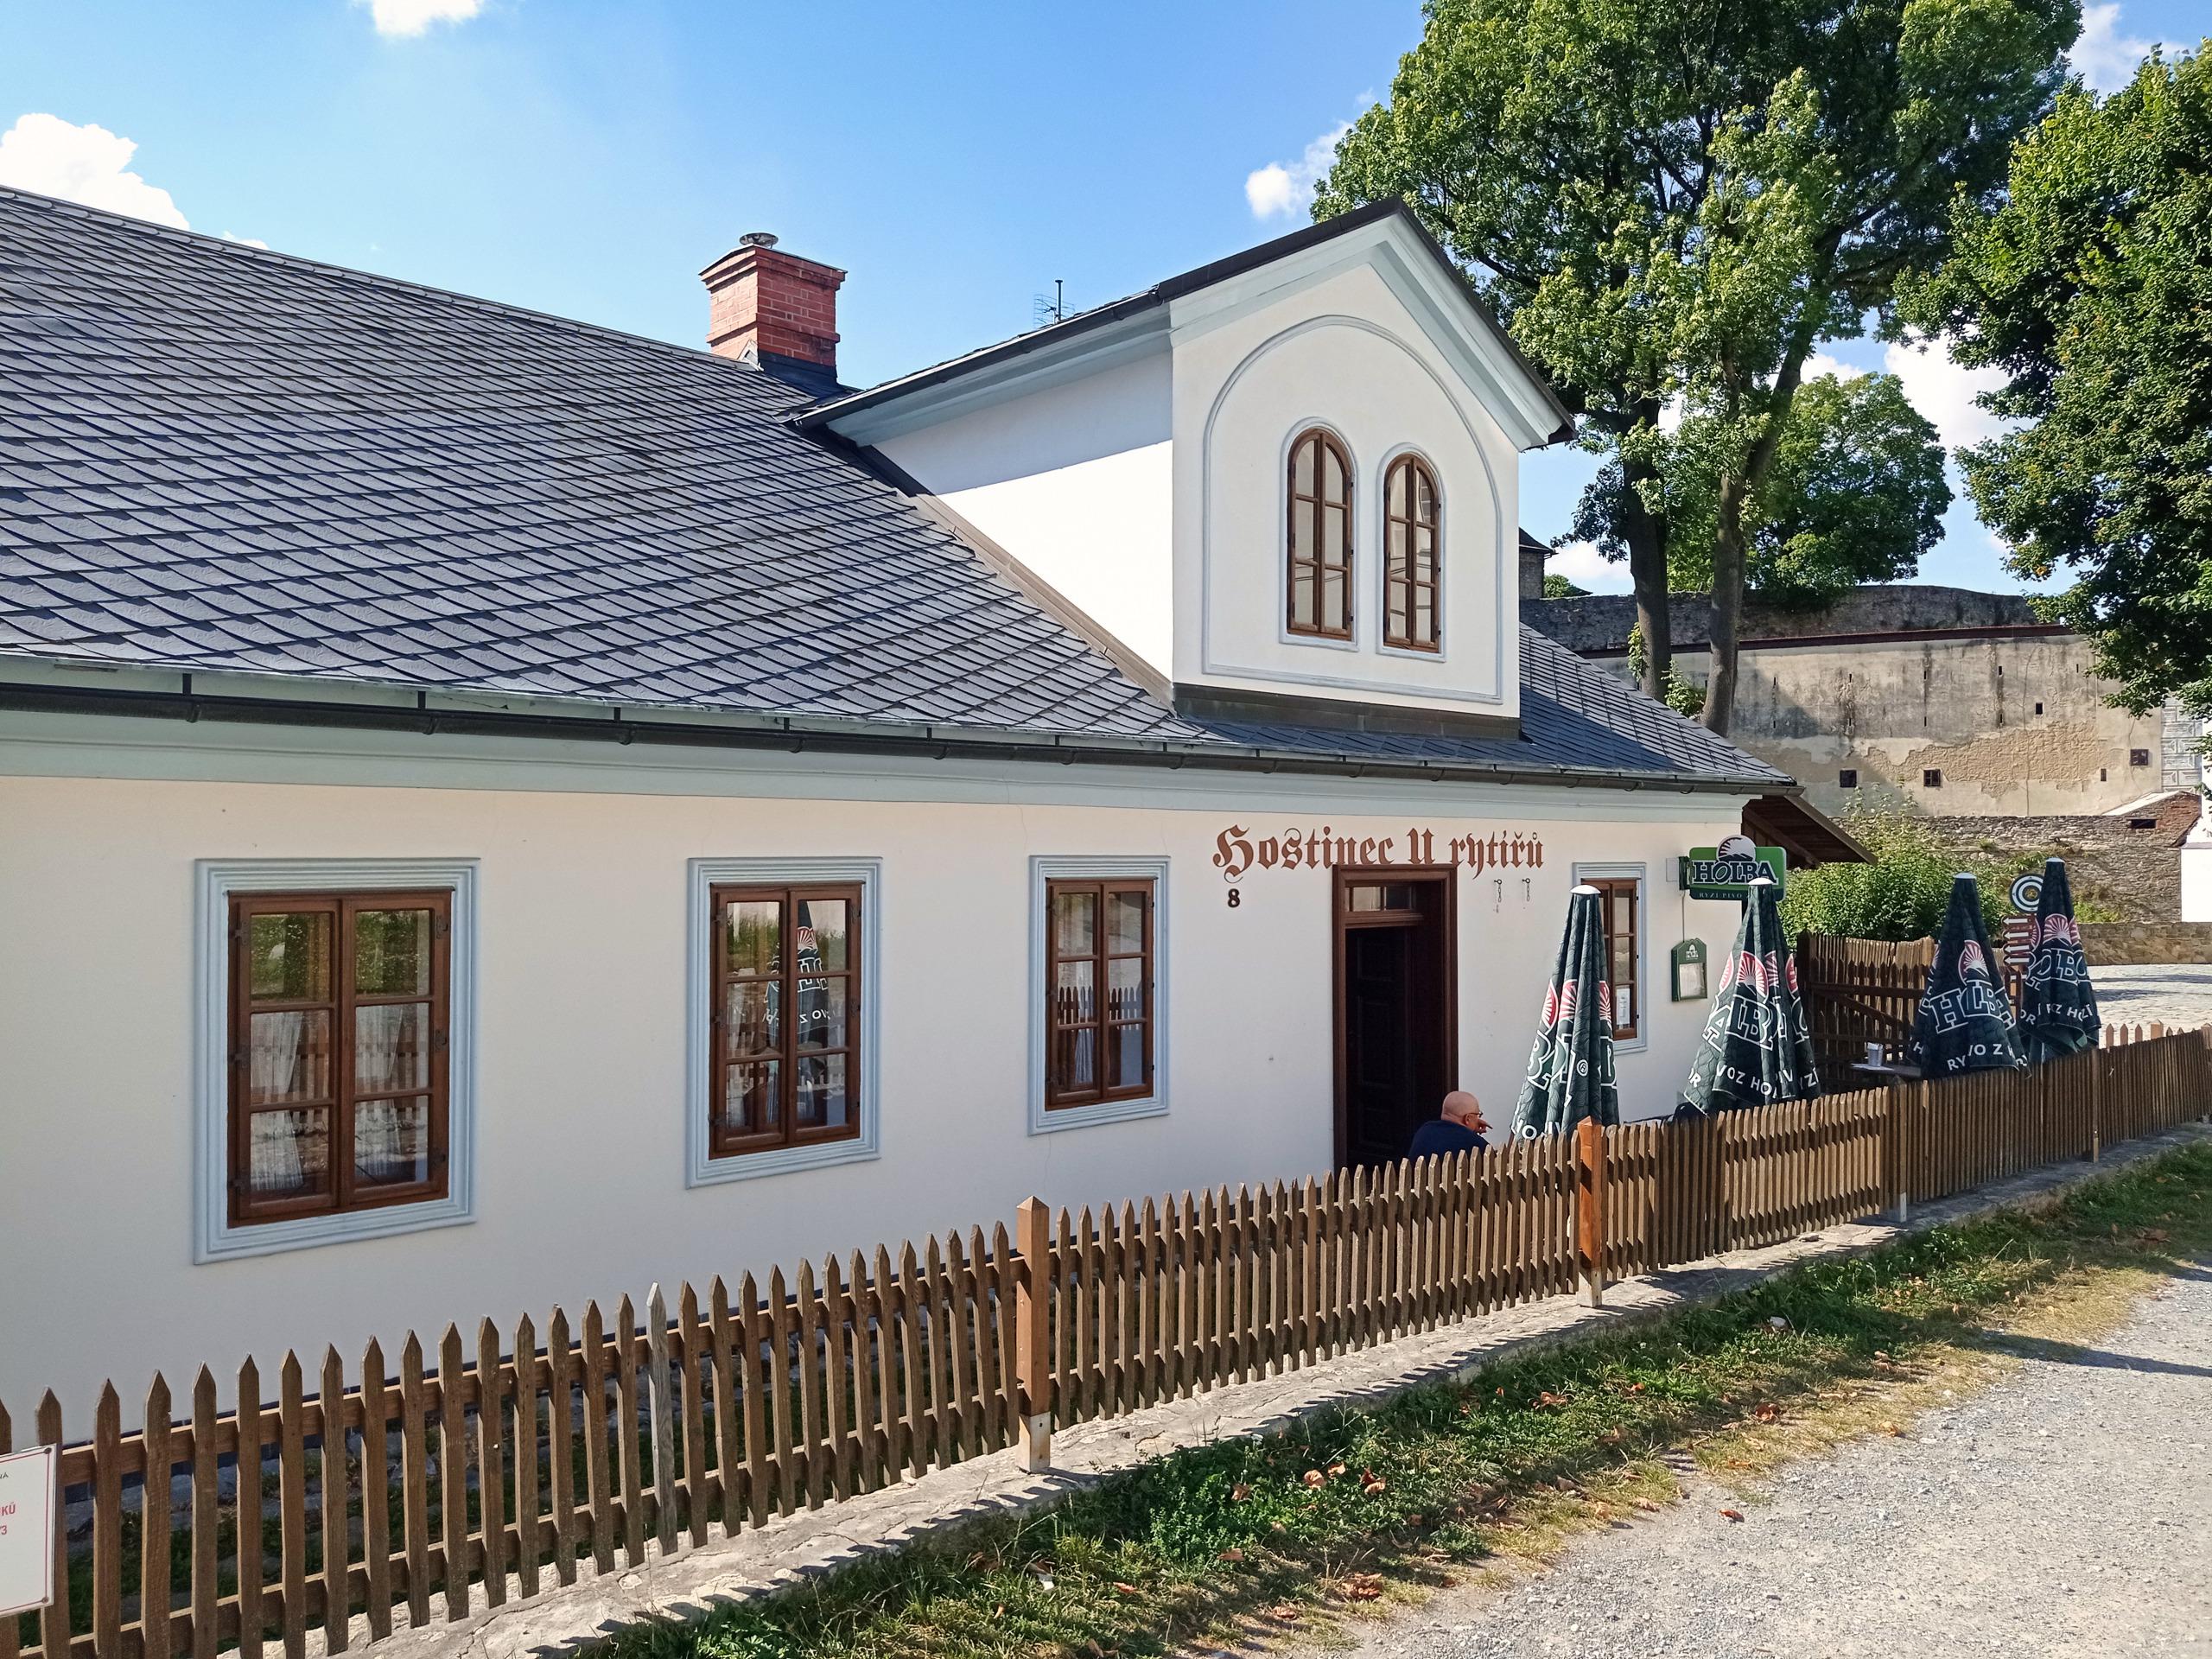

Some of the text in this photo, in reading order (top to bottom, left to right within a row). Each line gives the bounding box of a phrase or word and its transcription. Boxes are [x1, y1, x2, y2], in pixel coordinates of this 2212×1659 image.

[1212, 823, 1395, 884] Hostinec
[1693, 861, 1779, 885] HOLBA
[1227, 888, 1241, 908] 8
